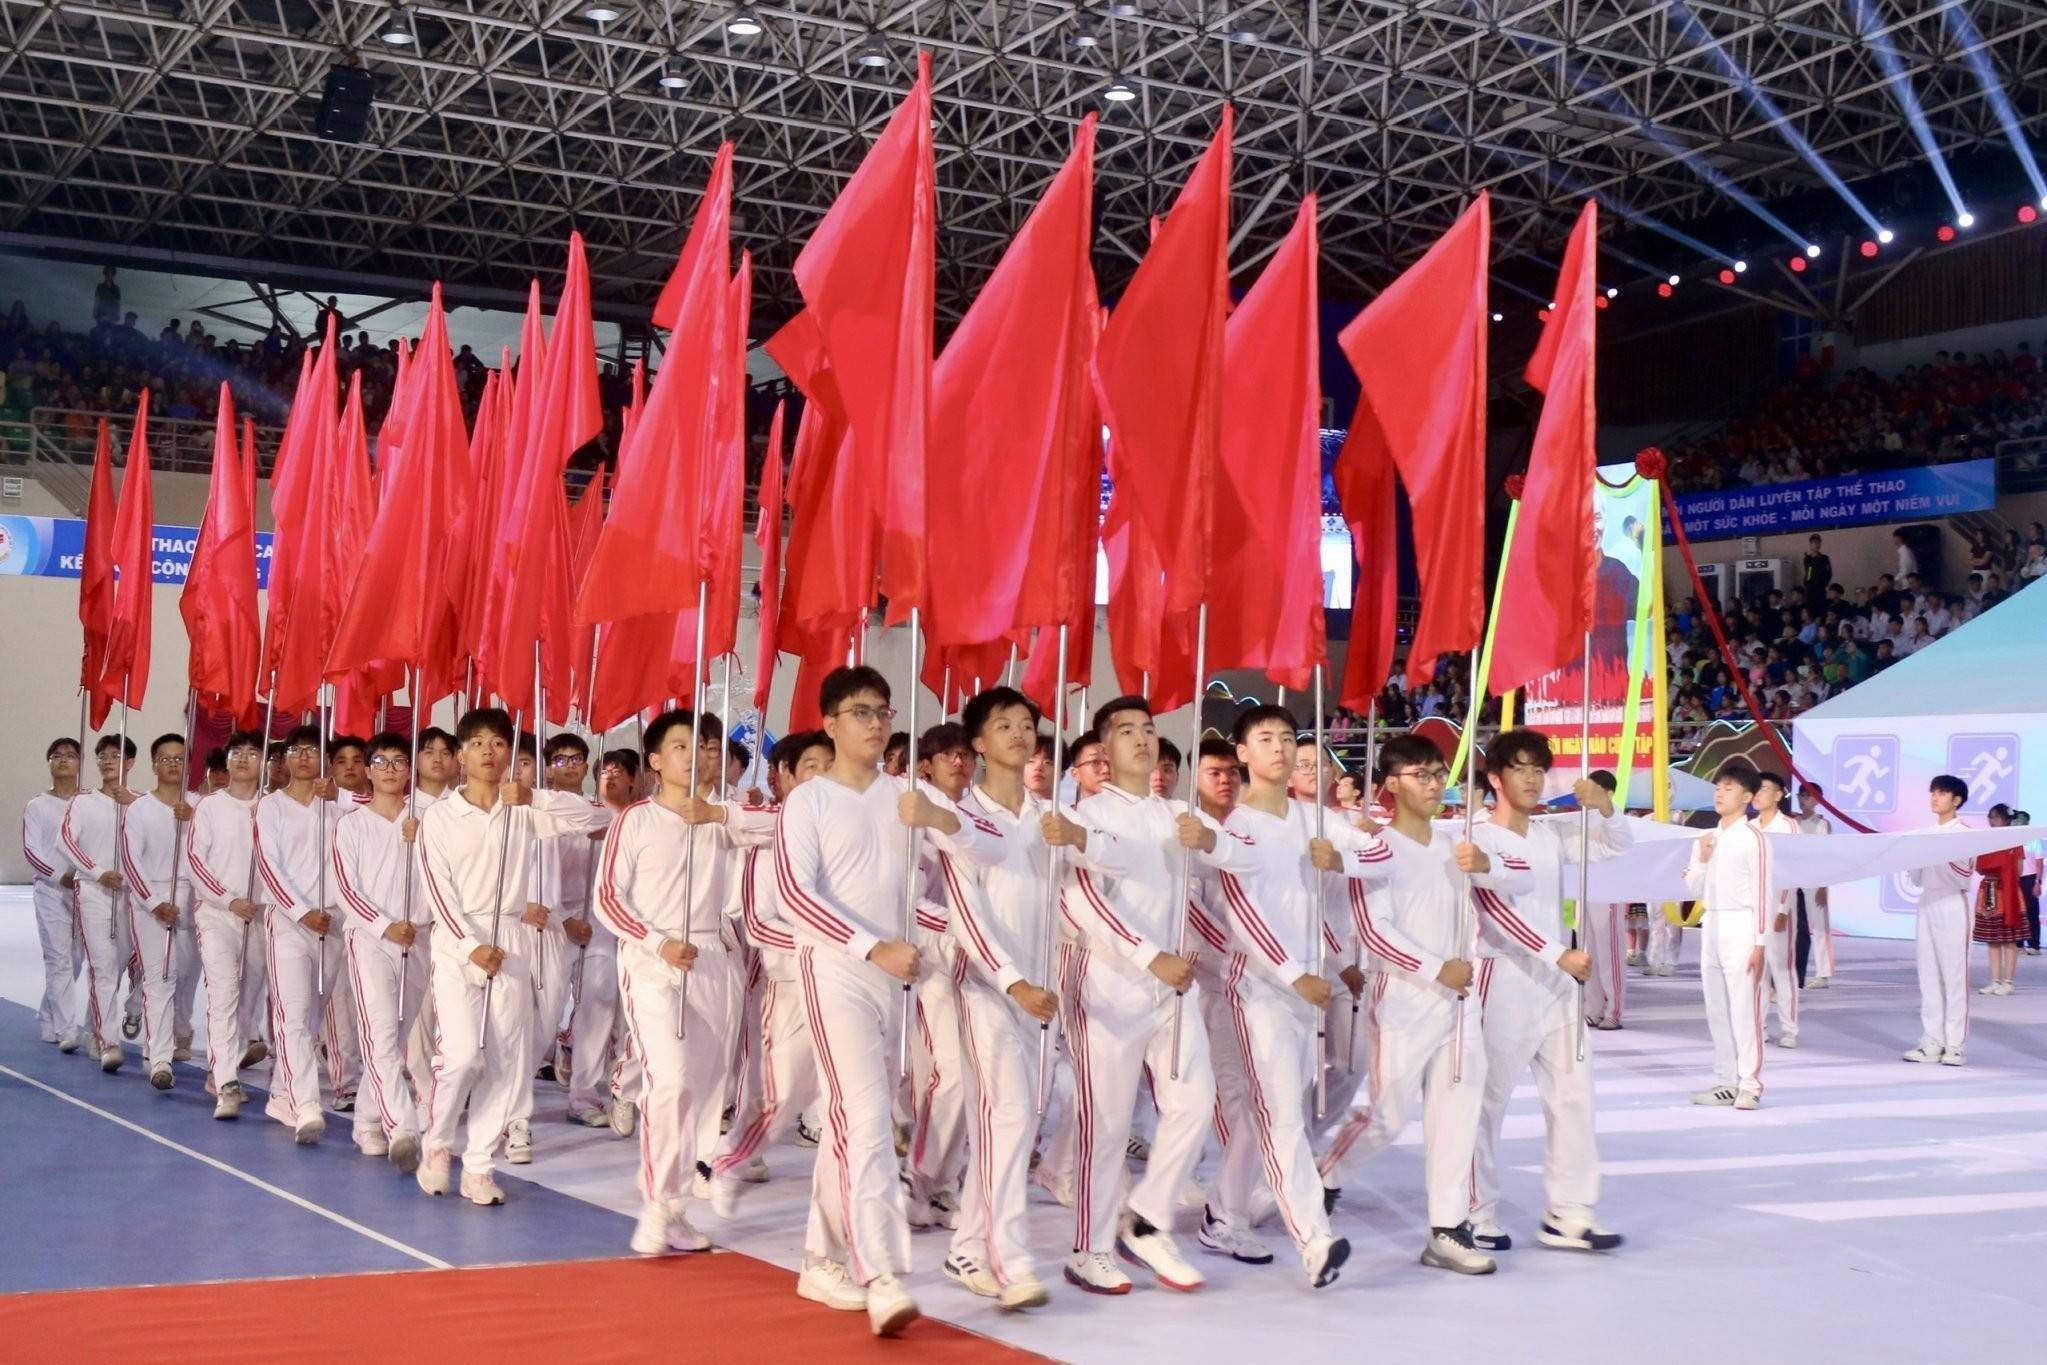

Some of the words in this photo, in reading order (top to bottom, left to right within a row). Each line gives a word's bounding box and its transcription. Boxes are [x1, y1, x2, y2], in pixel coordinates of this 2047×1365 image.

[1687, 497, 1725, 514] NGƯỜI
[1730, 496, 1754, 510] DÂN
[1760, 490, 1801, 507] LUYỆN
[1806, 486, 1831, 503] TẬP
[1836, 479, 1863, 496] THỂ
[1869, 480, 1905, 494] THAO
[1713, 515, 1738, 530] SỨC
[1820, 503, 1855, 518] NGÀY
[1861, 499, 1890, 517] MỘT
[1895, 493, 1931, 512] NIỀM
[1936, 494, 1960, 507] VUI
[152, 538, 196, 553] THAO
[152, 559, 188, 579] CỘN
